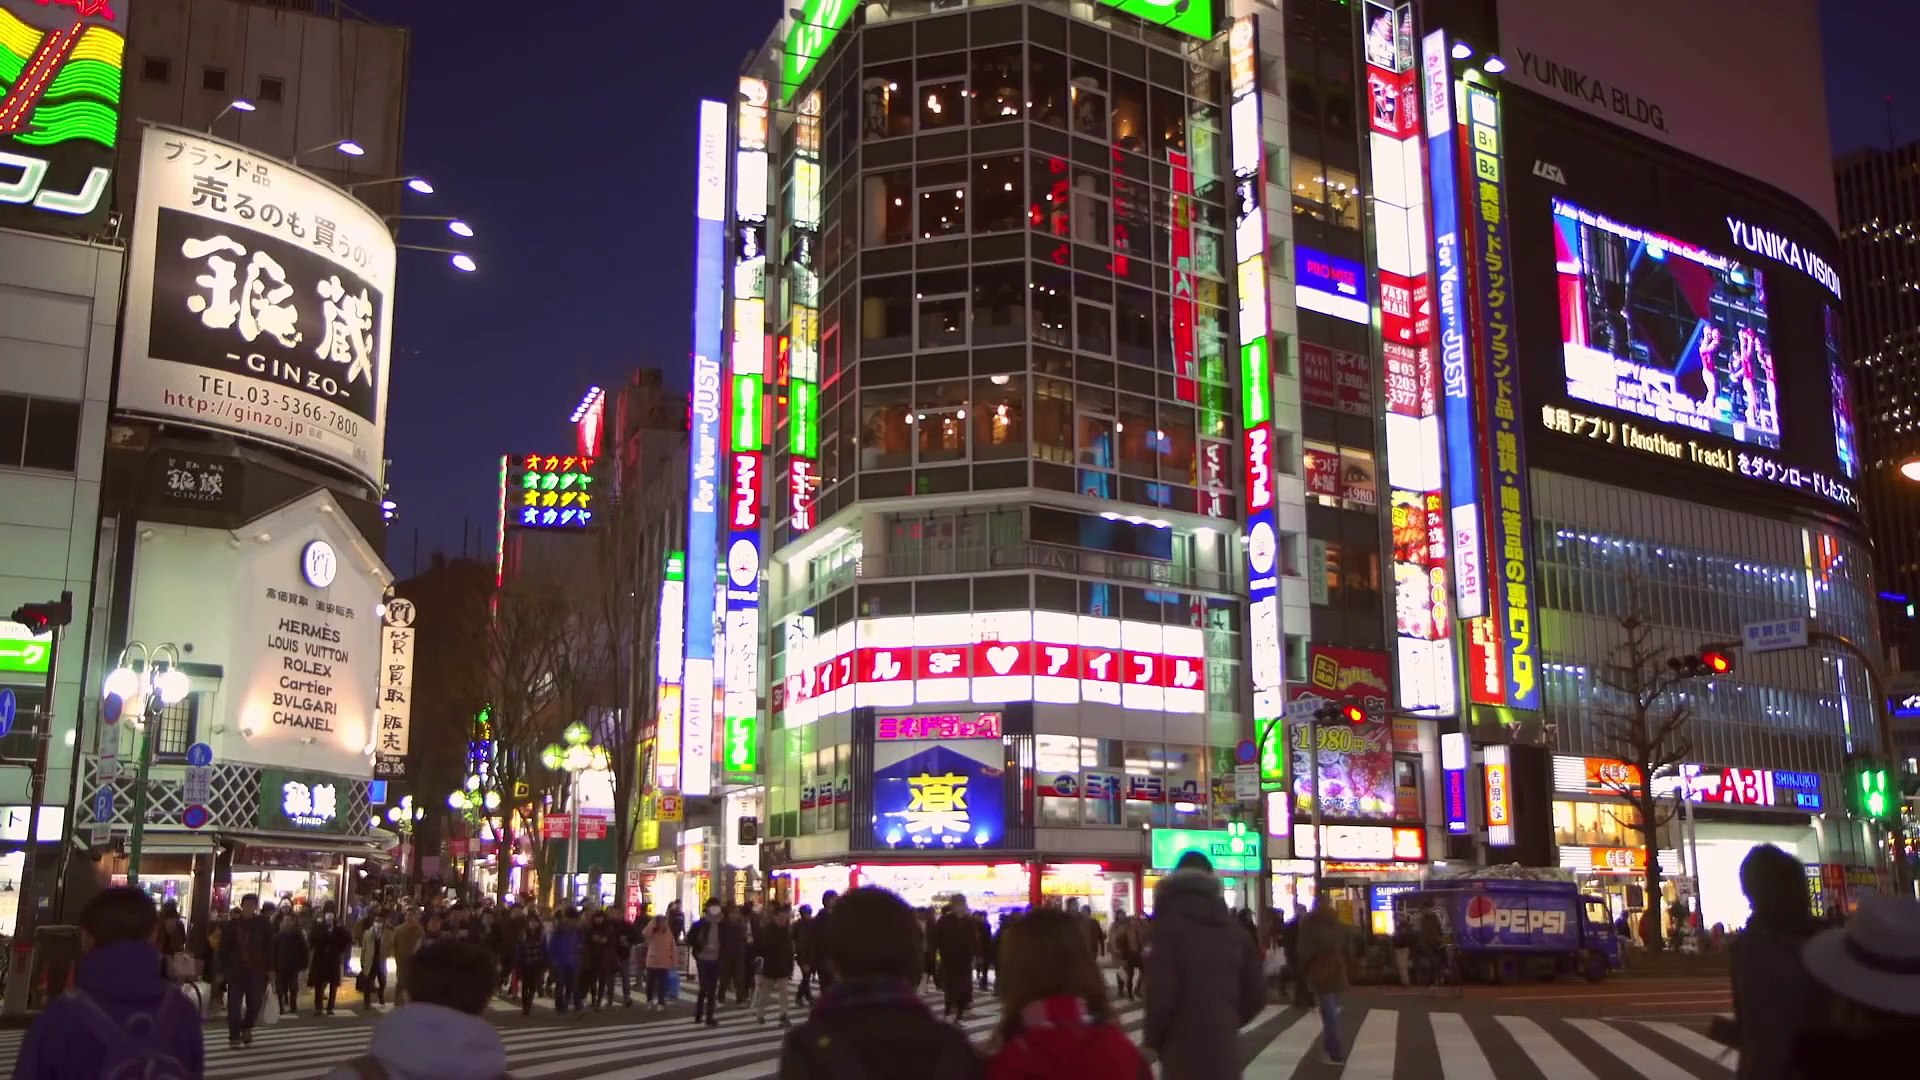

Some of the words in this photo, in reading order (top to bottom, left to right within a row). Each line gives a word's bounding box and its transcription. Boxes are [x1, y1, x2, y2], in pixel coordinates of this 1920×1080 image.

[1433, 70, 1444, 110] LABI
[1515, 47, 1608, 108] YUNIKA
[1611, 86, 1668, 134] BLDG.
[1479, 131, 1493, 148] B1
[163, 140, 271, 188] ブランド品
[1480, 158, 1496, 176] B2
[1533, 159, 1567, 186] LISA
[1438, 233, 1455, 267] For
[1726, 216, 1803, 271] YUNIKA
[1802, 247, 1842, 300] VISION
[1440, 268, 1457, 314] Your
[181, 234, 373, 387] 銀蔵
[1401, 362, 1415, 377] 03
[164, 389, 304, 436] http://ginzo.jp
[199, 374, 358, 438] TEL.03-5366-7800
[526, 454, 595, 471] オカダヤ
[694, 436, 716, 479] Your
[1249, 429, 1270, 507] アイフル
[523, 470, 594, 490] オカダヤ
[736, 455, 756, 525] アイフル
[523, 490, 593, 508] オカダヤ
[693, 486, 714, 513] For
[523, 507, 592, 525] オカダヤ
[1464, 551, 1476, 595] LABI
[268, 634, 299, 655] LOUIS
[305, 641, 349, 665] VUITTON
[283, 656, 332, 678] ROLEX
[1045, 647, 1197, 688] アイフル
[280, 676, 333, 697] Cartier
[273, 692, 337, 716] BVLGARI
[273, 711, 334, 732] CHANEL
[879, 713, 1001, 739] ミネドラッグ
[1488, 770, 1503, 821] 吉野家
[1775, 772, 1817, 788] SHINJUKU
[906, 772, 971, 835] 薬
[1494, 909, 1567, 935] PEPSI
